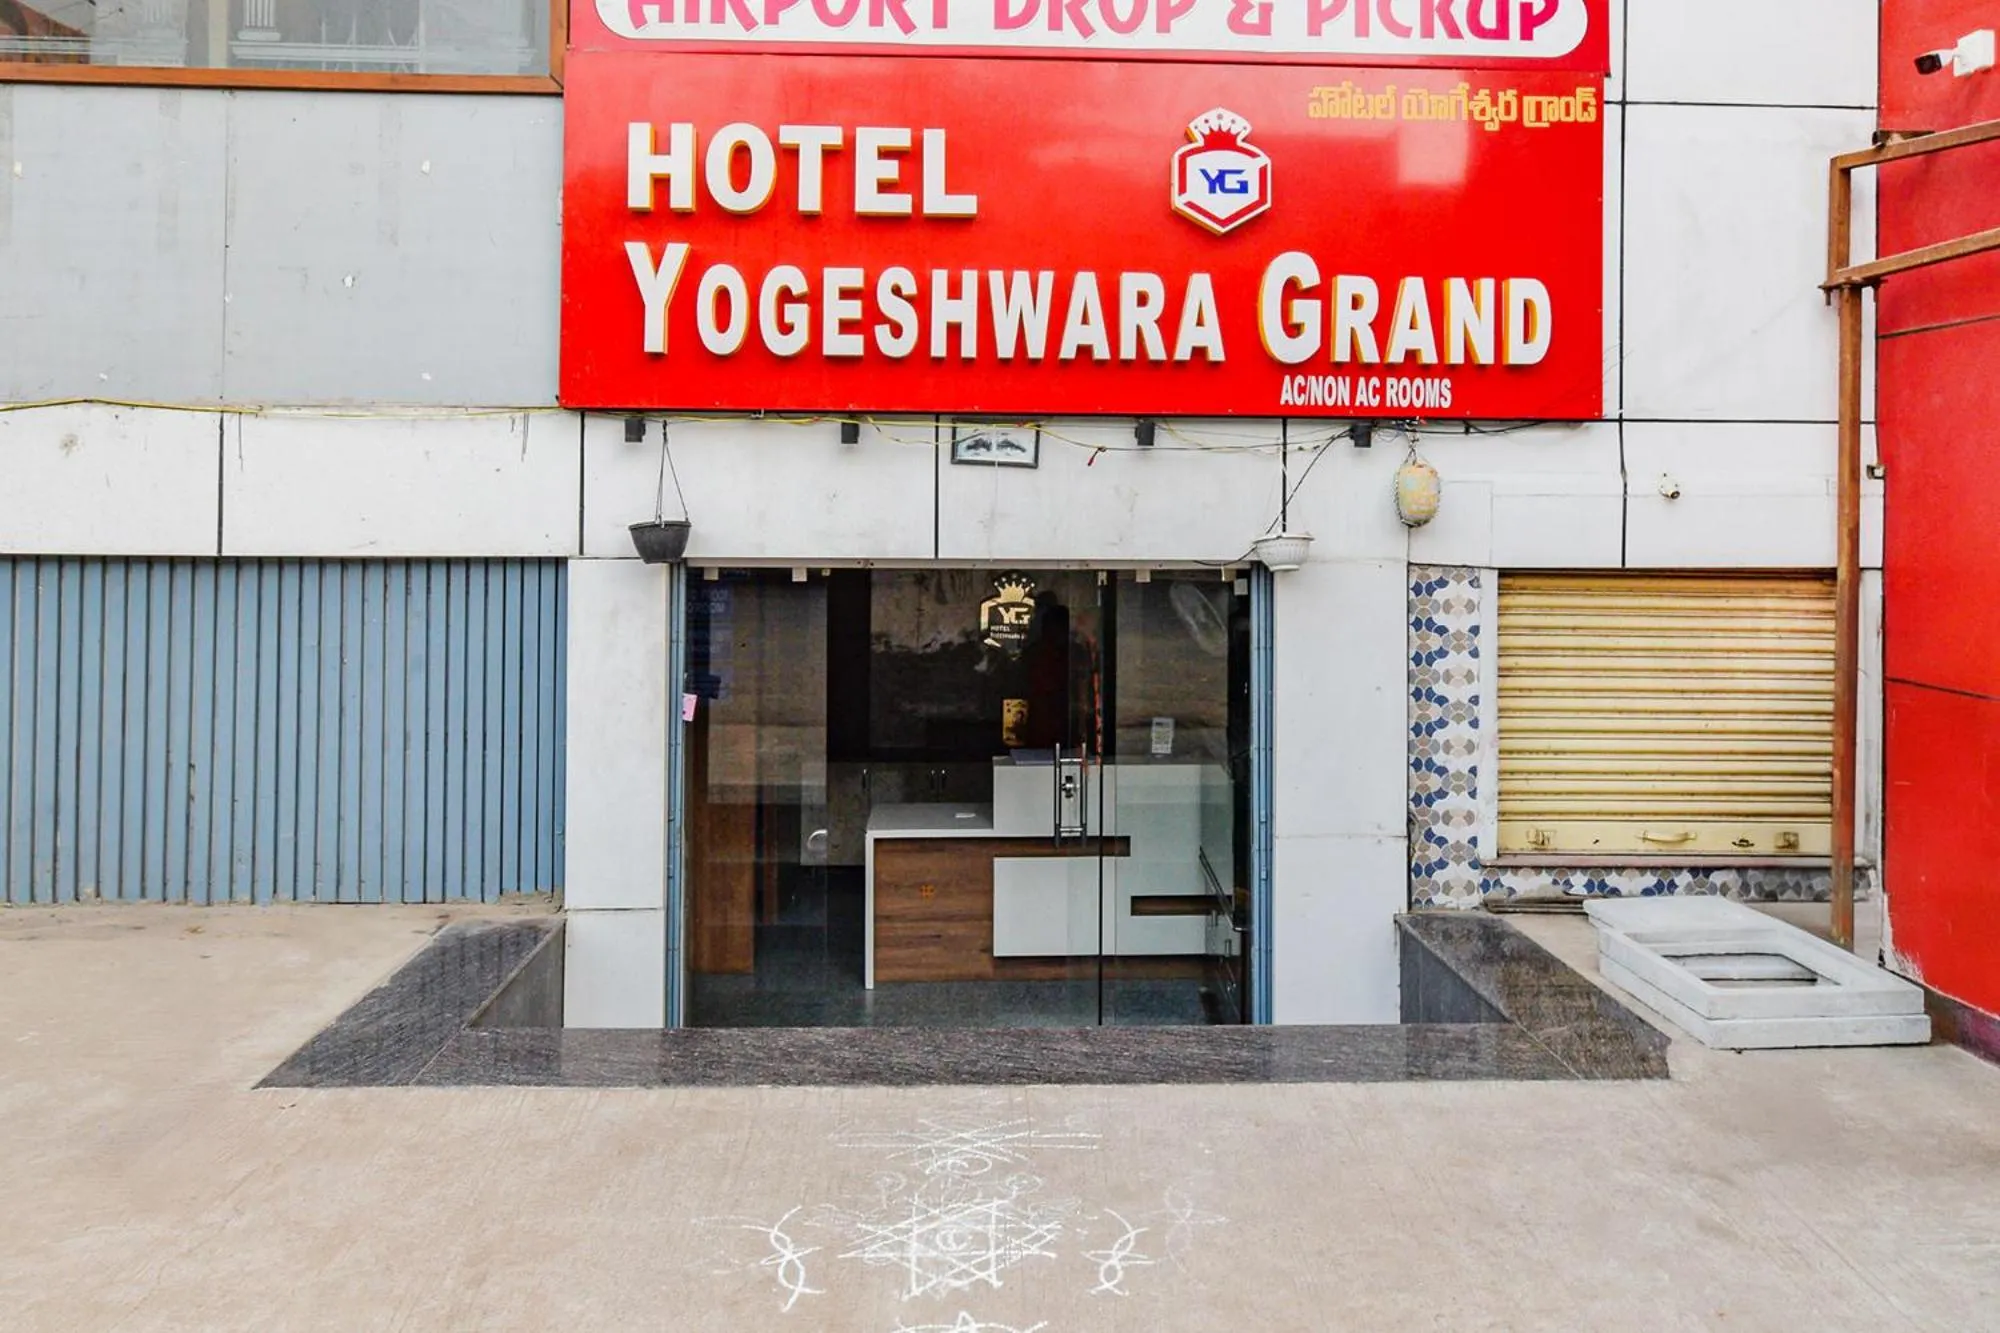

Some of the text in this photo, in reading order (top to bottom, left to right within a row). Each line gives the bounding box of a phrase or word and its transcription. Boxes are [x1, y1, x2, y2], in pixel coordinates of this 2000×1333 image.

[627, 121, 979, 217] HOTEL
[1199, 168, 1249, 194] YG
[624, 241, 1552, 366] YOGESHWARA GRAND
[1280, 374, 1452, 408] AC/NON AC ROOMS
